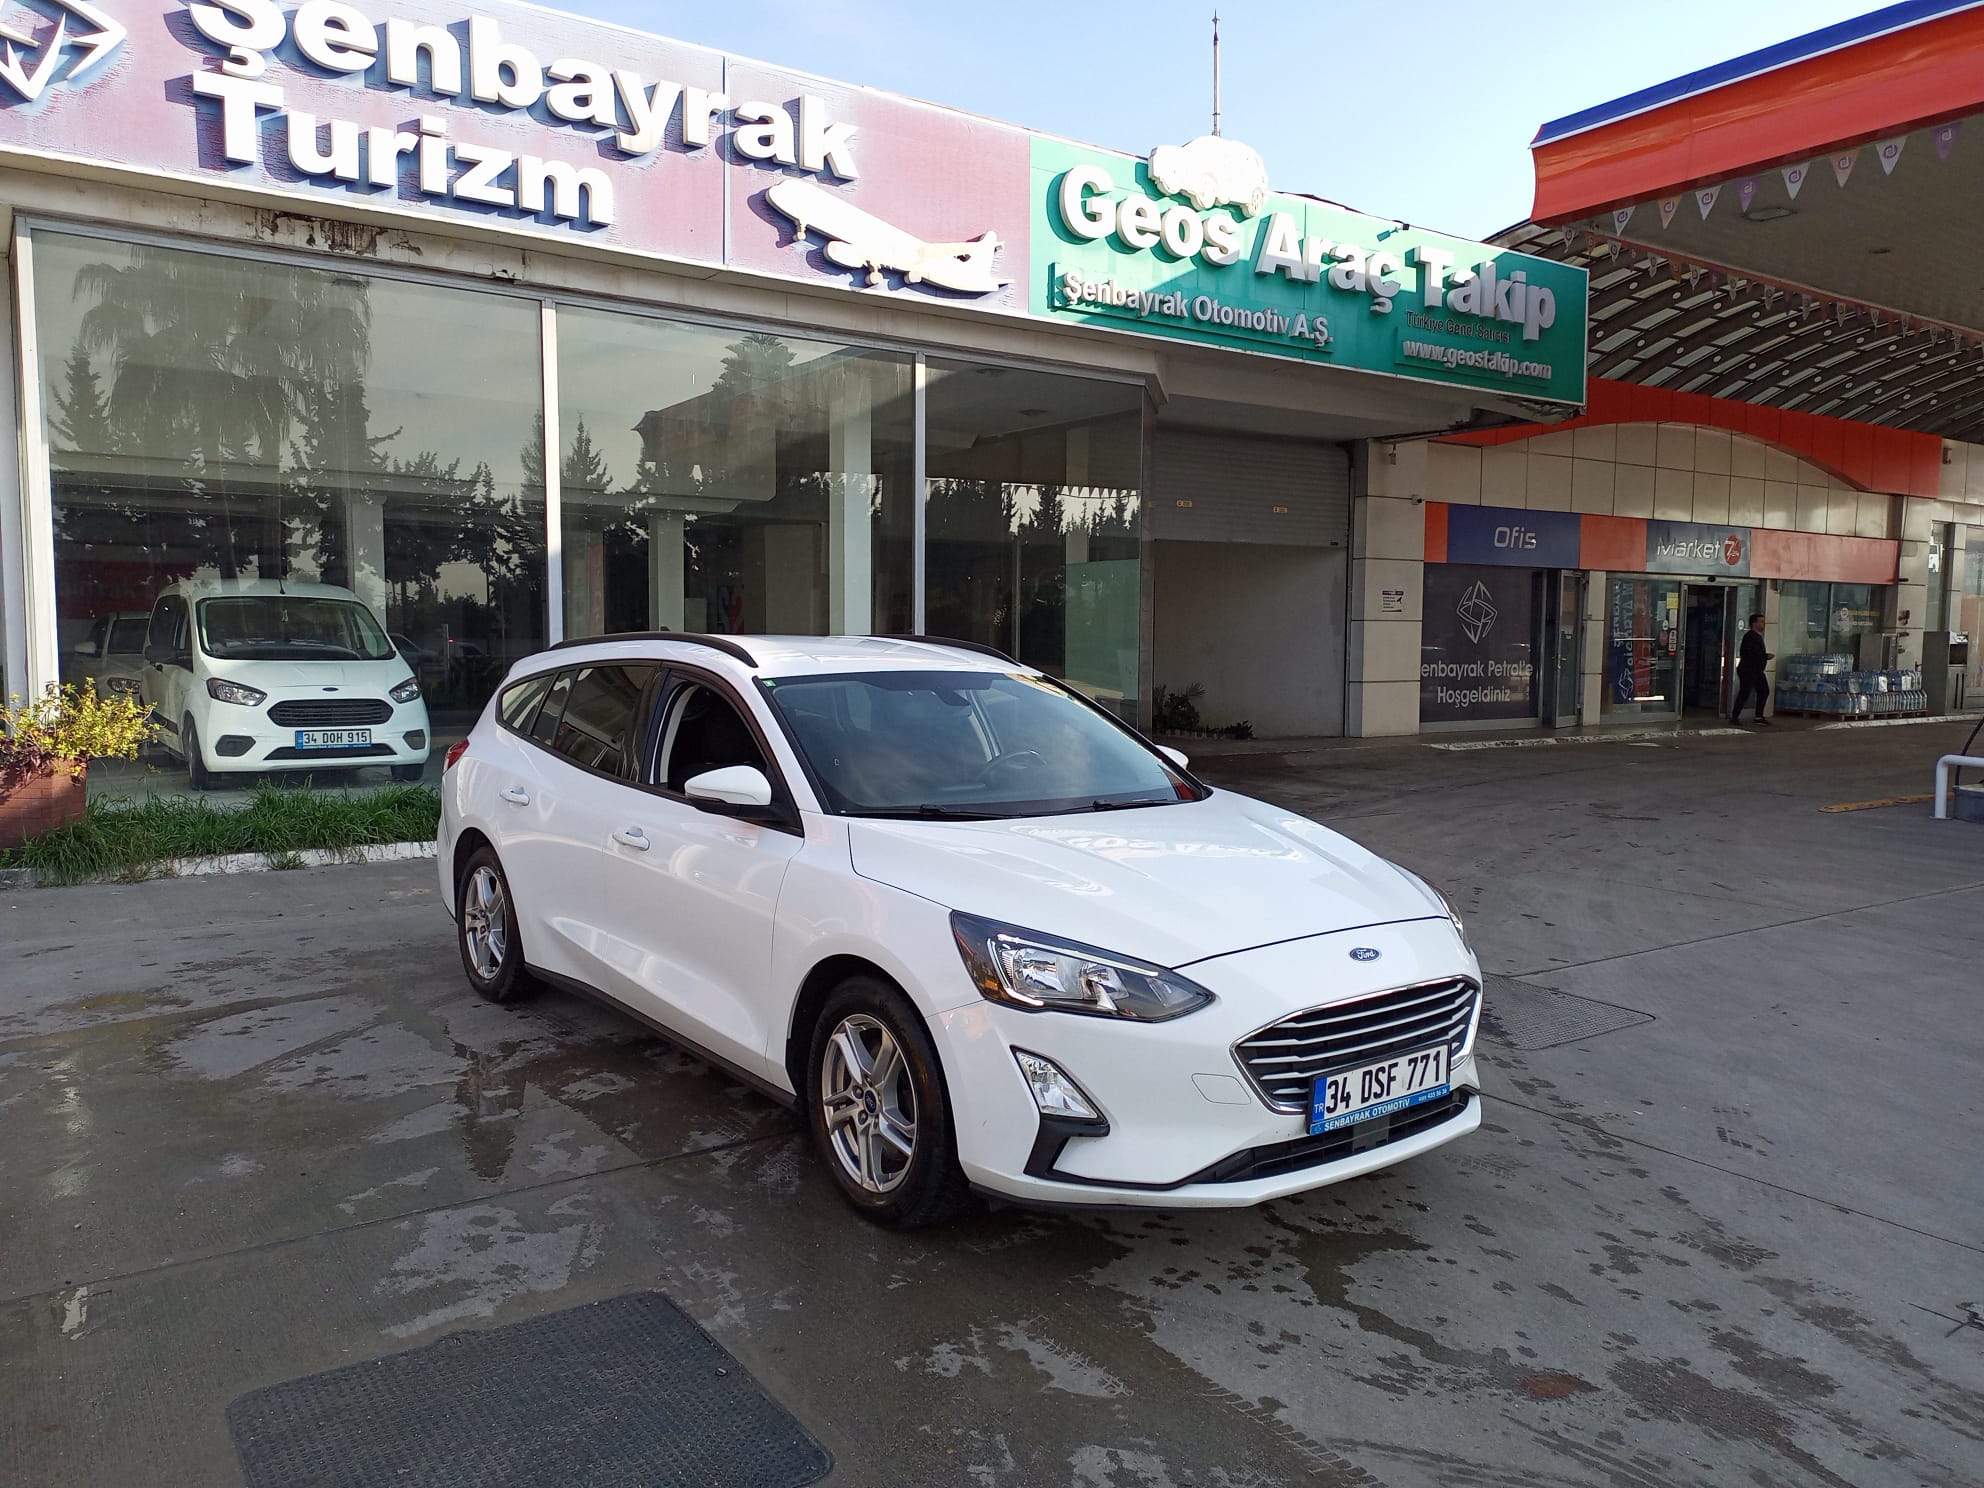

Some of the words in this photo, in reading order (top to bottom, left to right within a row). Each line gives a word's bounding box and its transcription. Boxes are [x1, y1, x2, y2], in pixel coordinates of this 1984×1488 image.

[187, 0, 860, 181] Şenbayrak
[192, 69, 614, 227] Turizm
[1058, 164, 1241, 268] Geos
[1254, 212, 1401, 314] Araç
[1413, 245, 1556, 341] Takip
[1063, 271, 1189, 319] Şenbayrak
[1193, 294, 1290, 335] Otomotiv
[1289, 313, 1334, 348] A.Ş.
[1402, 340, 1552, 380] www.geostakip.com
[1494, 526, 1537, 550] Ofis
[1657, 536, 1721, 560] Market
[1422, 660, 1484, 681] enbayrak
[1437, 685, 1511, 708] Hoşgeldiniz
[304, 732, 317, 744] 34
[347, 731, 368, 743] 915
[1325, 1076, 1351, 1114] 34
[1360, 1061, 1399, 1104] DSF
[1406, 1050, 1441, 1091] 771
[1314, 1102, 1324, 1113] TR
